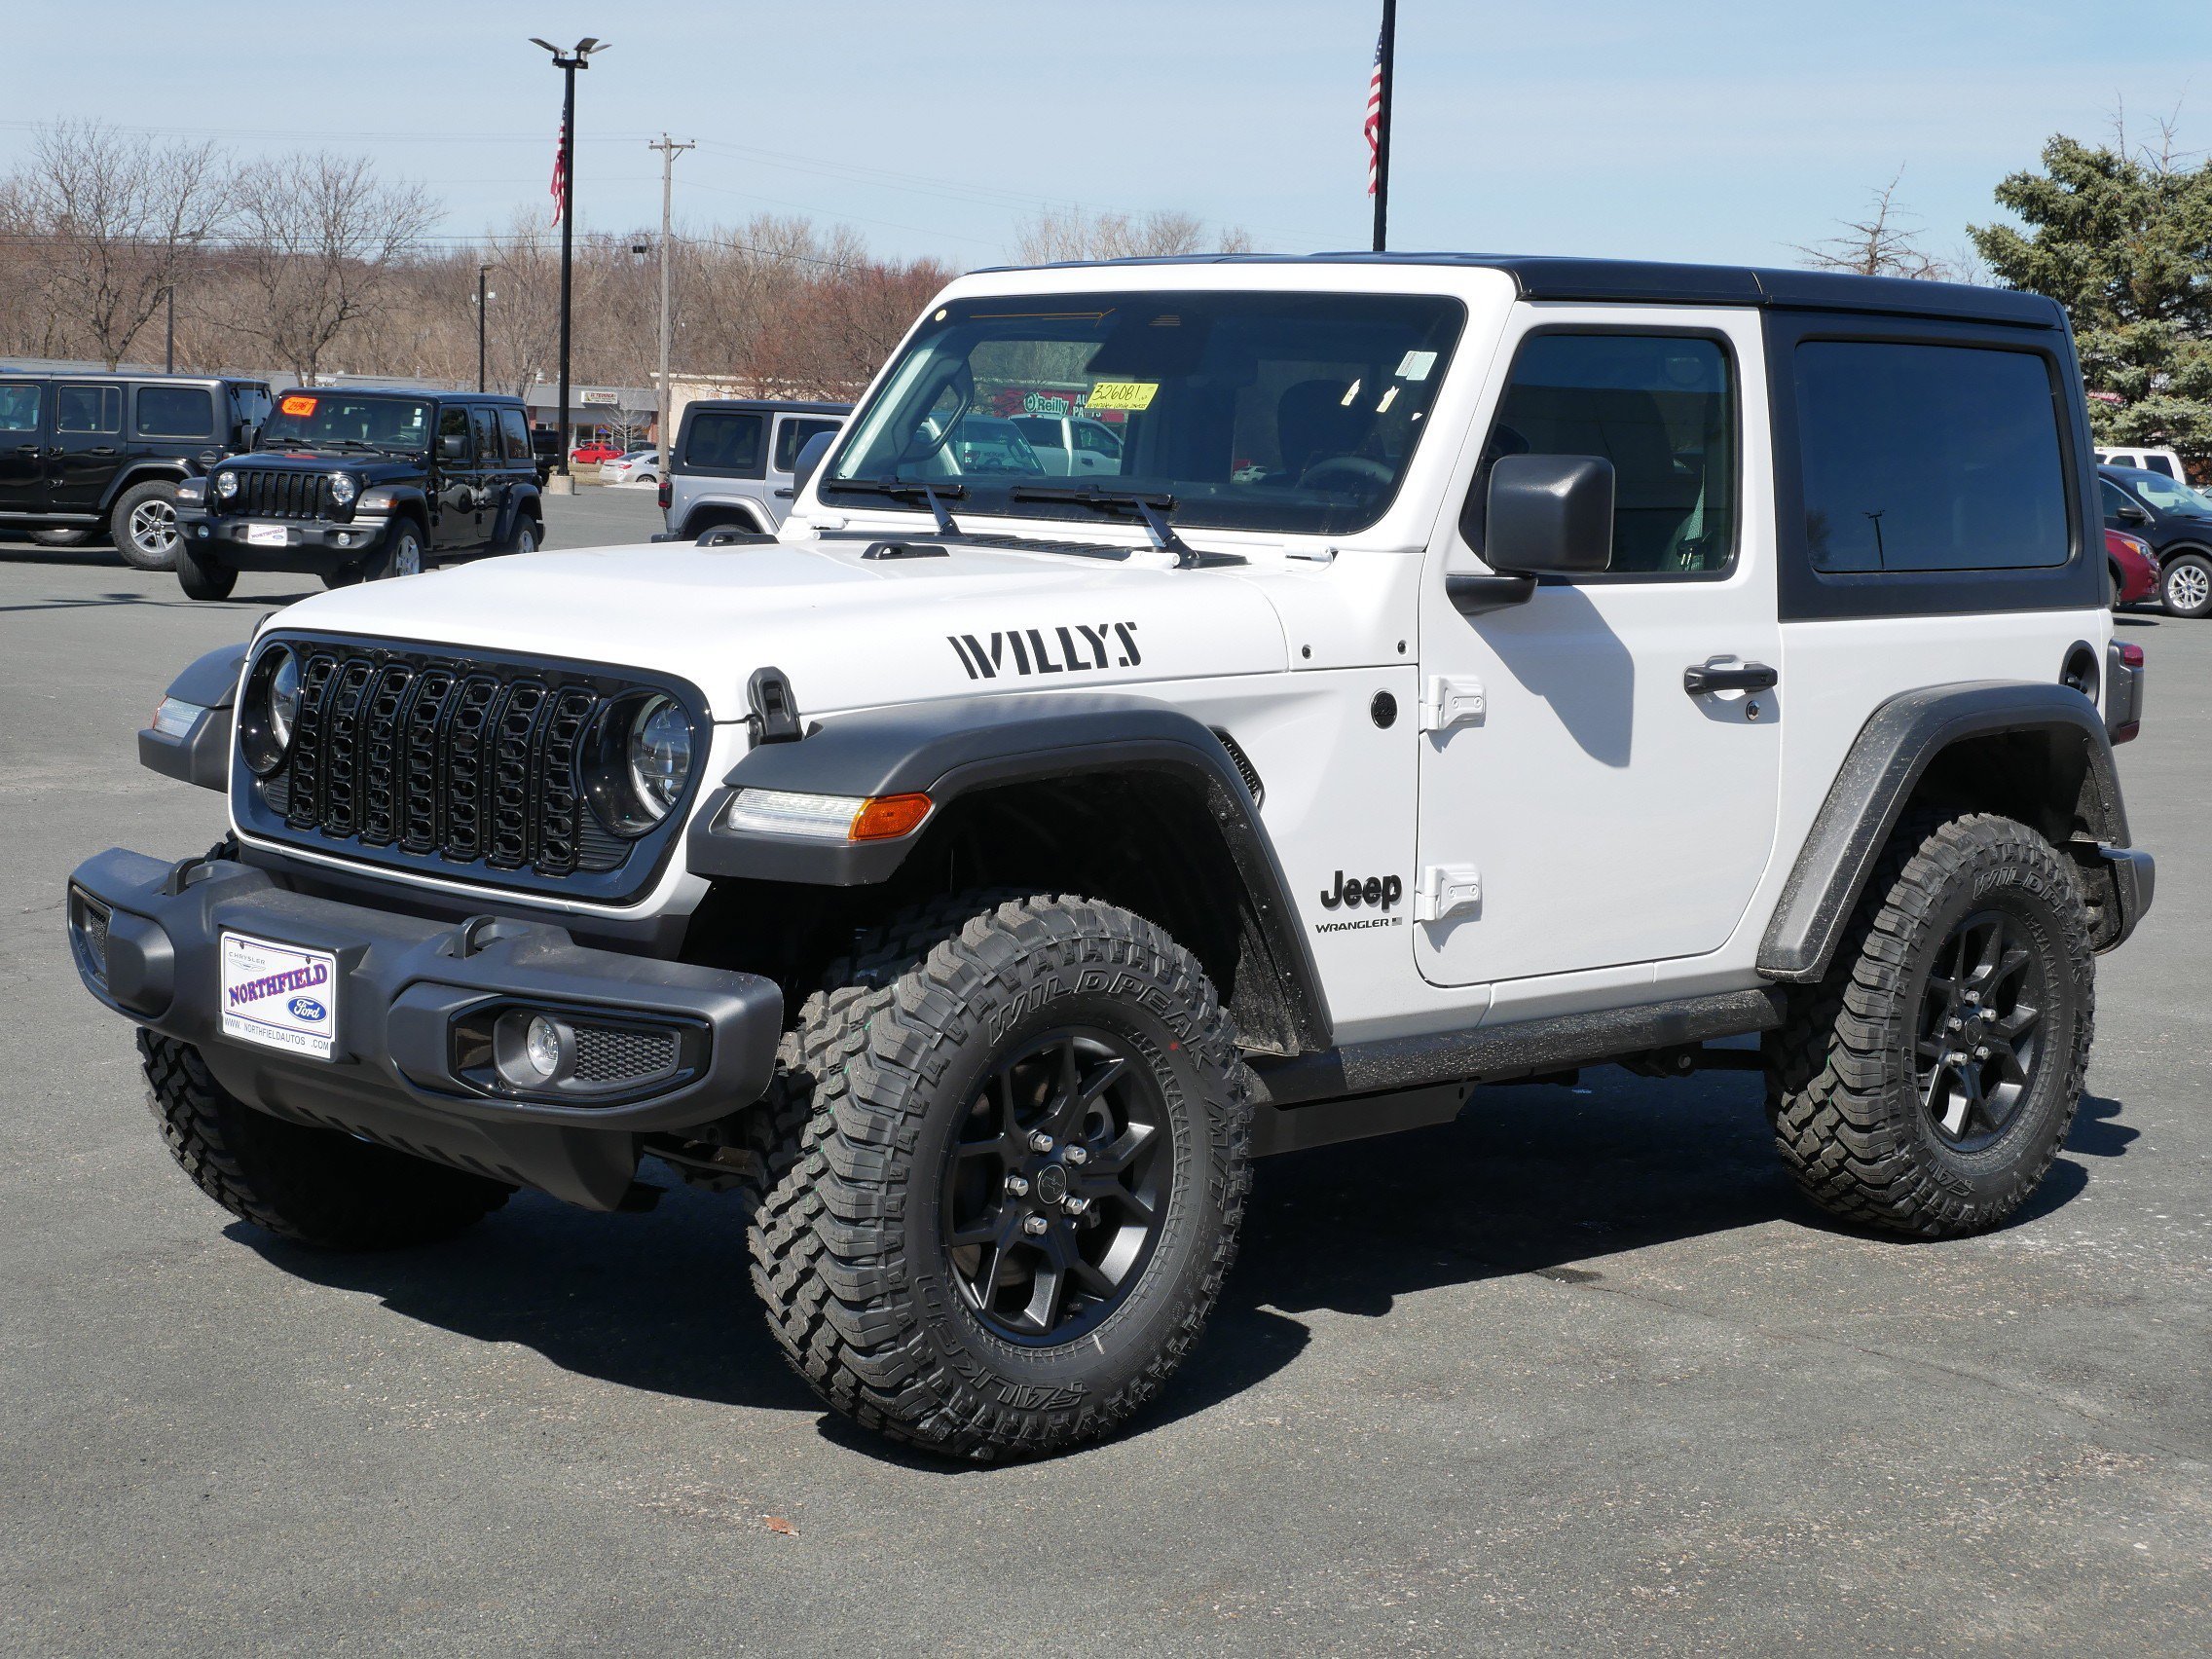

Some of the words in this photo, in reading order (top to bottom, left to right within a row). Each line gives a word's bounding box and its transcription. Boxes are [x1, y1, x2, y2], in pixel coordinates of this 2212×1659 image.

[1023, 391, 1070, 414] O'Reilly
[1092, 385, 1141, 401] 326081
[946, 622, 1142, 681] WILLYS
[1320, 869, 1402, 912] Jeep
[1315, 918, 1389, 934] WRANGLER
[228, 951, 266, 965] CHRYSLER
[228, 963, 328, 1007] NORTHFIELD
[293, 998, 321, 1019] Ford
[987, 968, 1216, 1072] WILDPEAK
